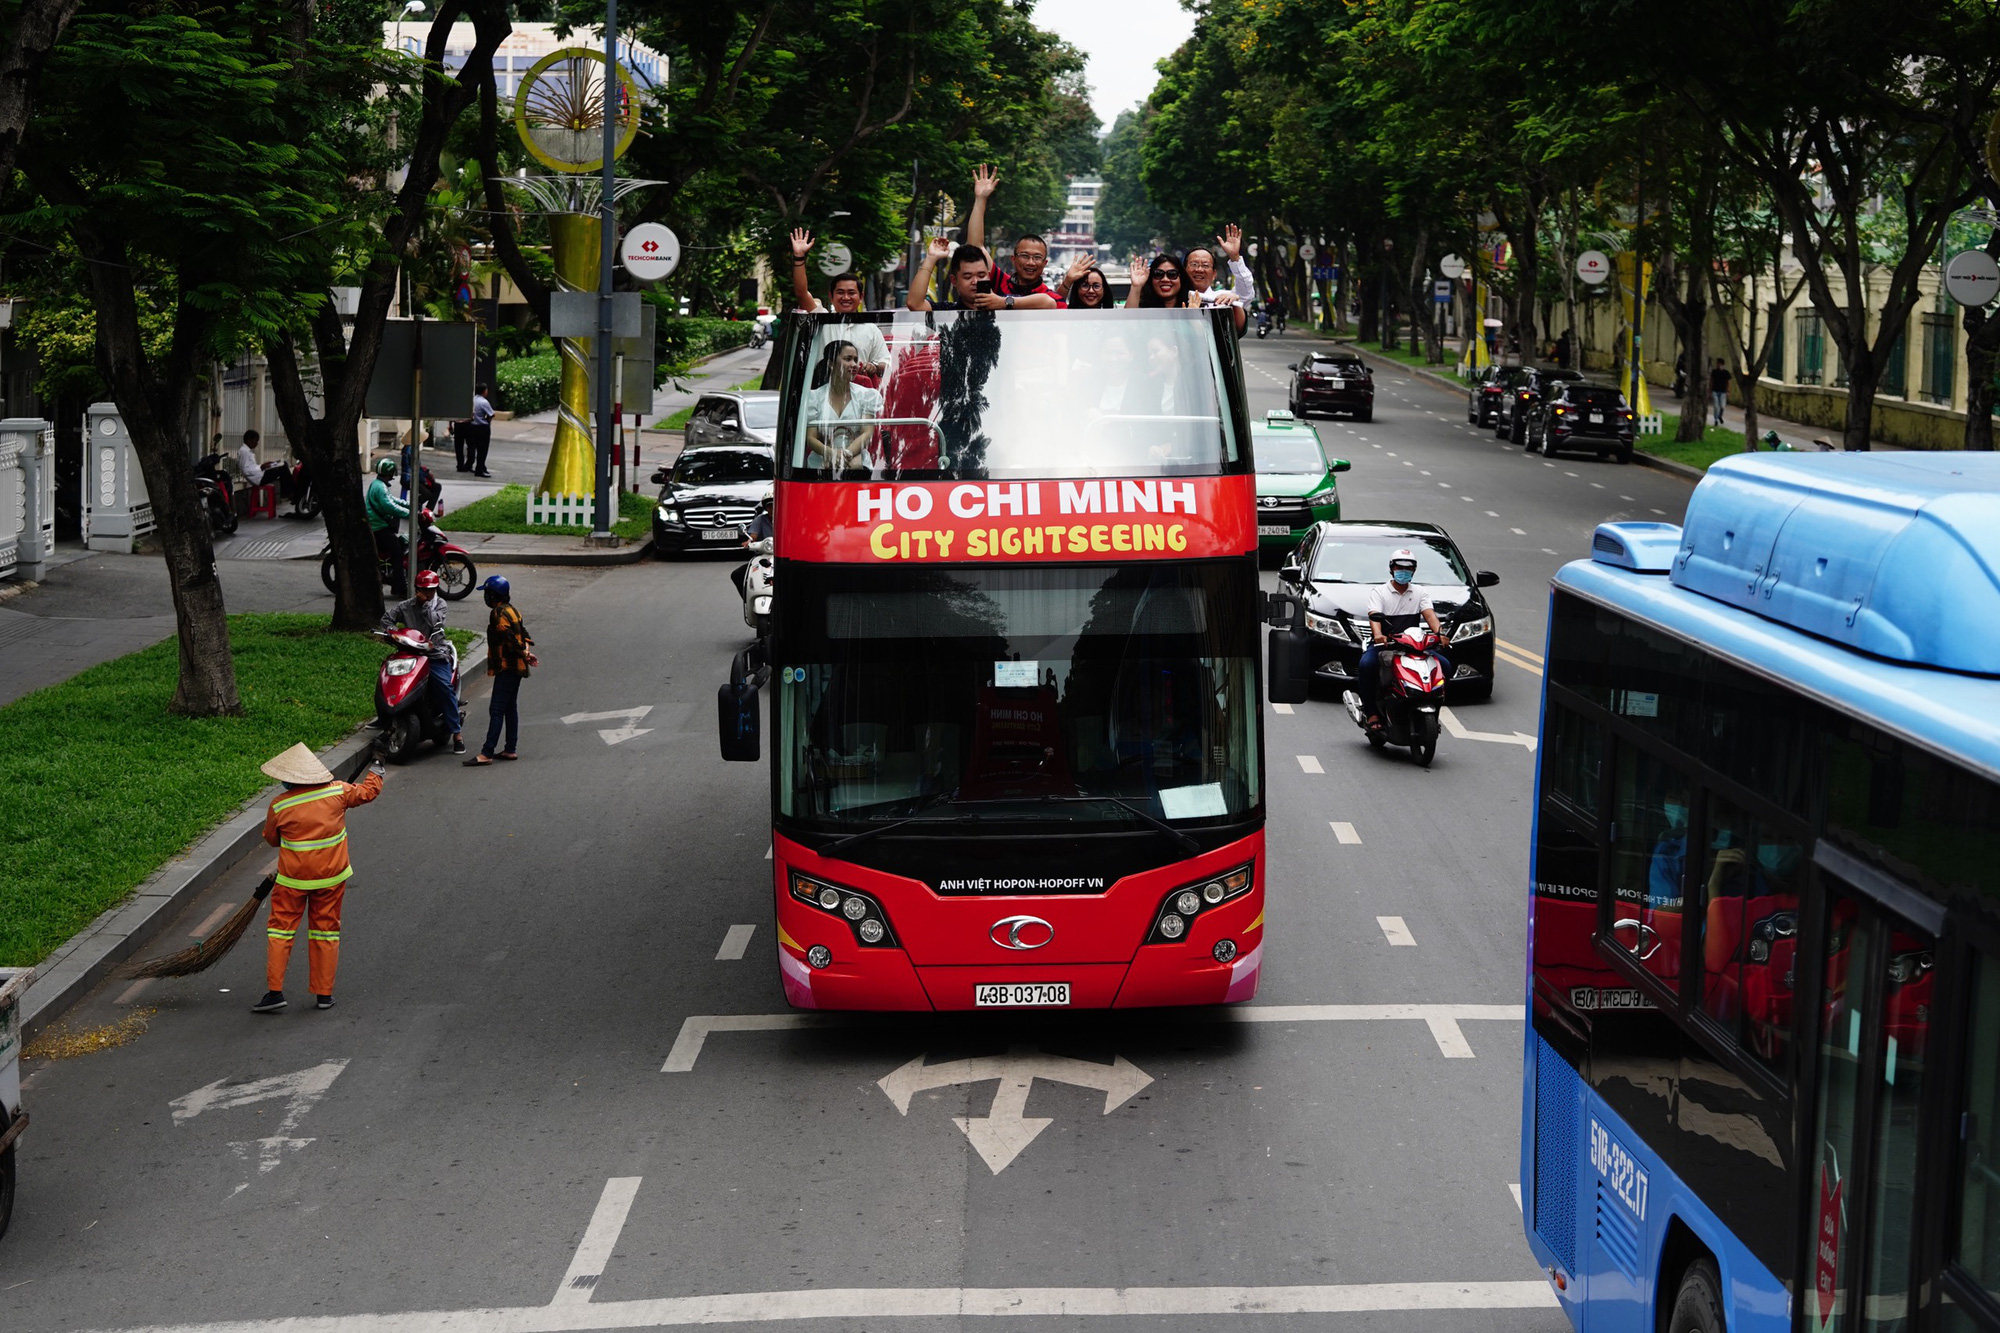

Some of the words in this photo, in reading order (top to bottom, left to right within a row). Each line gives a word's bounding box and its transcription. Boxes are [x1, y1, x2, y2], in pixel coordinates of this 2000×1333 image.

[857, 486, 933, 522] HO
[949, 482, 1041, 519] CHI
[1058, 480, 1197, 515] MINH
[967, 523, 1187, 557] SIGHTSEEING
[939, 879, 965, 890] ANH
[967, 877, 991, 891] VIỆT
[993, 878, 1085, 889] HOPON-HOPOFF
[1087, 877, 1104, 888] VN
[979, 986, 1067, 1004] 43B-037.08
[1590, 1118, 1648, 1221] 51B-322.17
